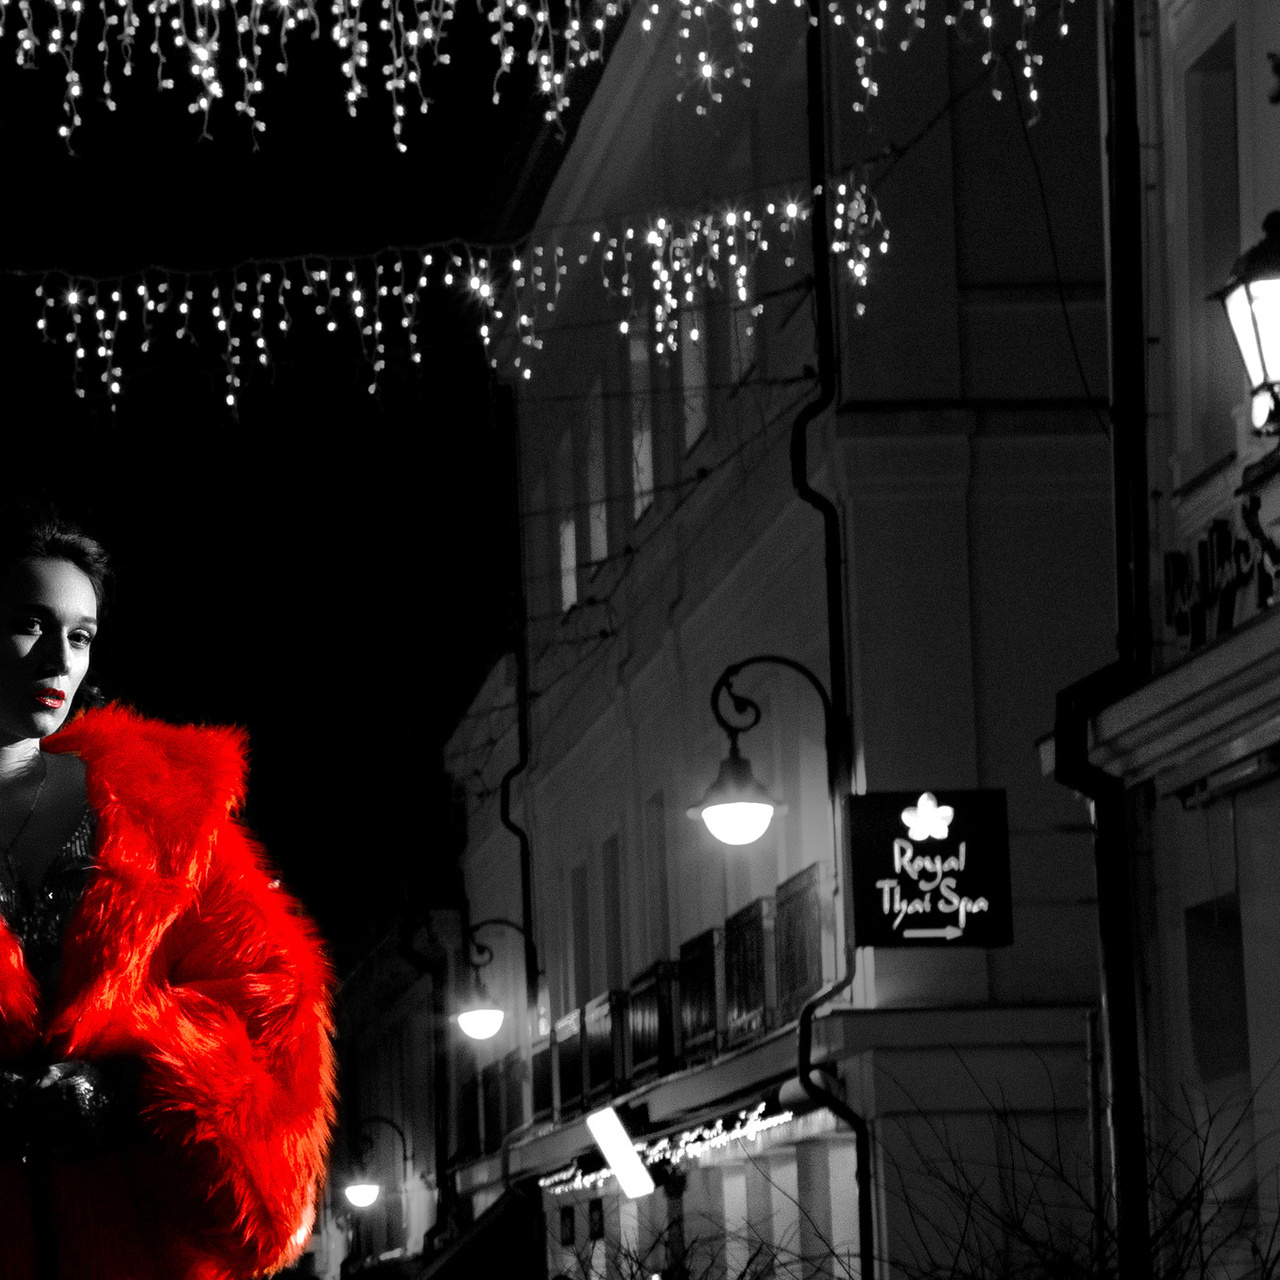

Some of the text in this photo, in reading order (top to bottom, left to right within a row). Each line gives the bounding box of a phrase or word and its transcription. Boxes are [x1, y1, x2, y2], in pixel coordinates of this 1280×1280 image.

[893, 837, 967, 892] Royal
[875, 876, 990, 931] Thai Spa
